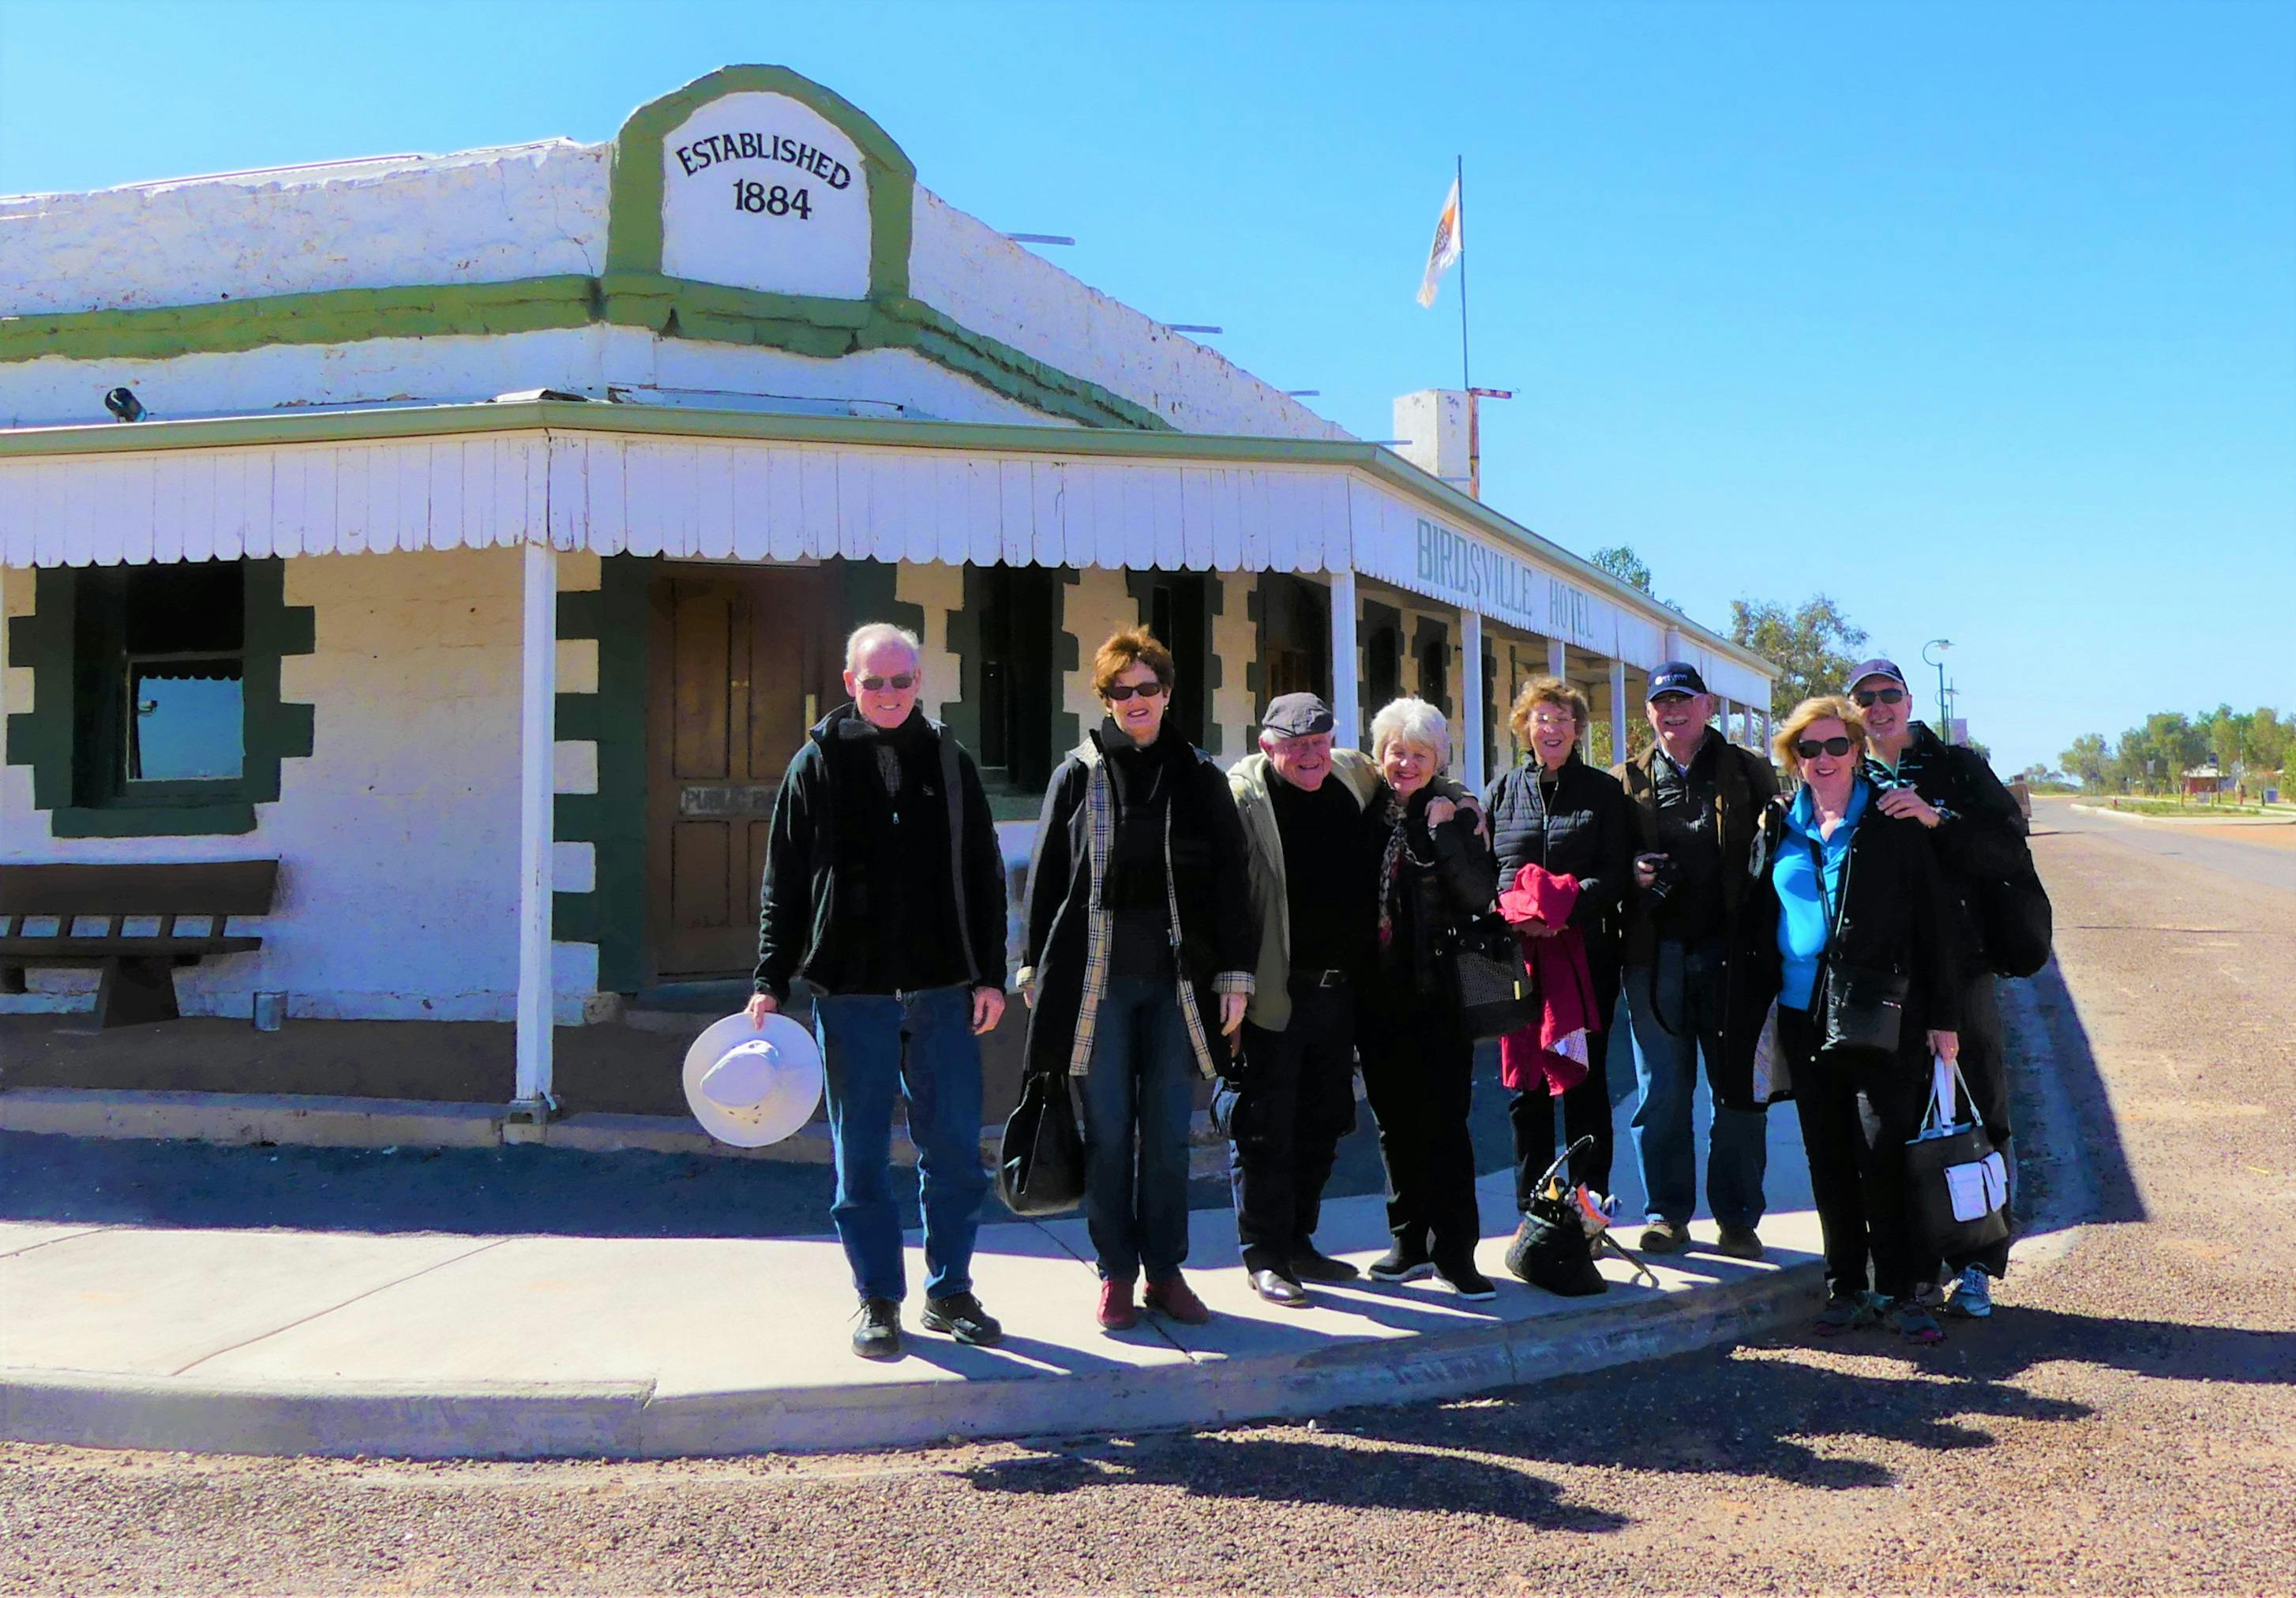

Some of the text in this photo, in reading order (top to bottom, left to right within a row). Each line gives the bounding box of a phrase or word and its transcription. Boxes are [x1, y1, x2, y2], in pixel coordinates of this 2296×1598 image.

[676, 133, 851, 189] ESTABLISHED
[733, 178, 812, 220] 1884
[1417, 518, 1593, 639] BIRDSVILLE HOTEL
